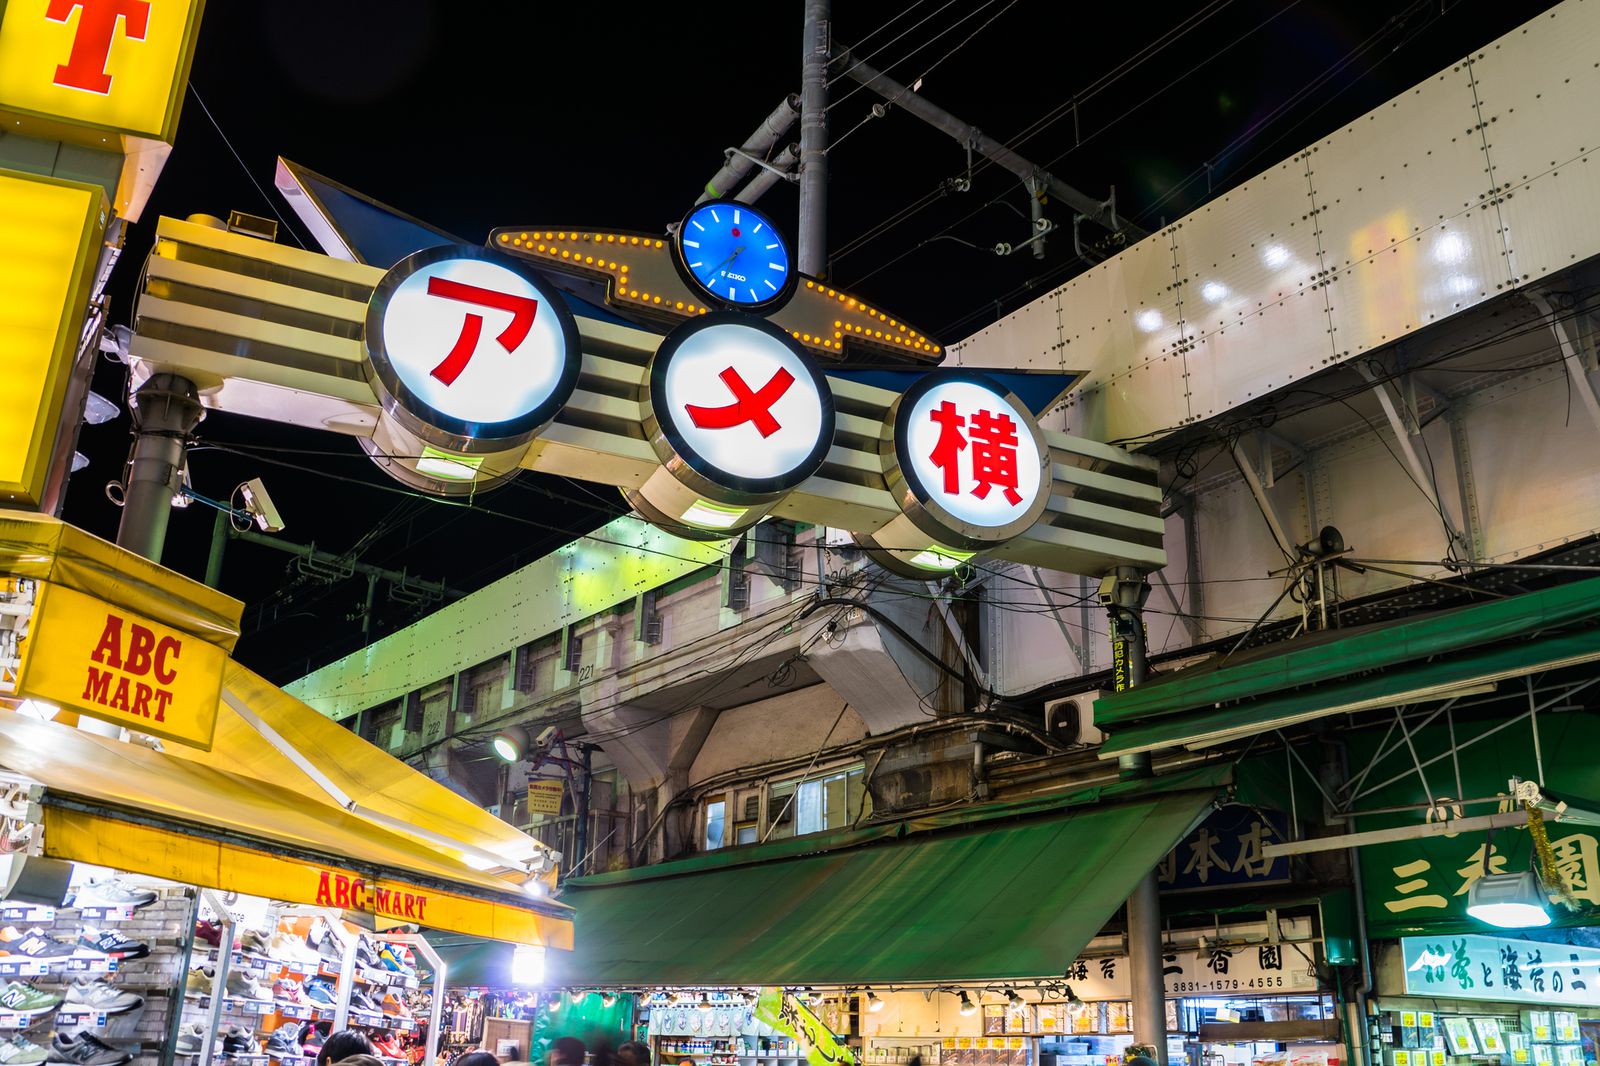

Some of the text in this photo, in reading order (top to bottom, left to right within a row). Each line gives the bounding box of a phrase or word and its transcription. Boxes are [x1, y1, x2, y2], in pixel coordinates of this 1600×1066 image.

[45, 0, 151, 96] T
[91, 613, 182, 686] ABC
[578, 664, 595, 682] 221
[82, 665, 174, 723] MART
[427, 720, 441, 736] 222
[315, 871, 427, 920] ABC-MART
